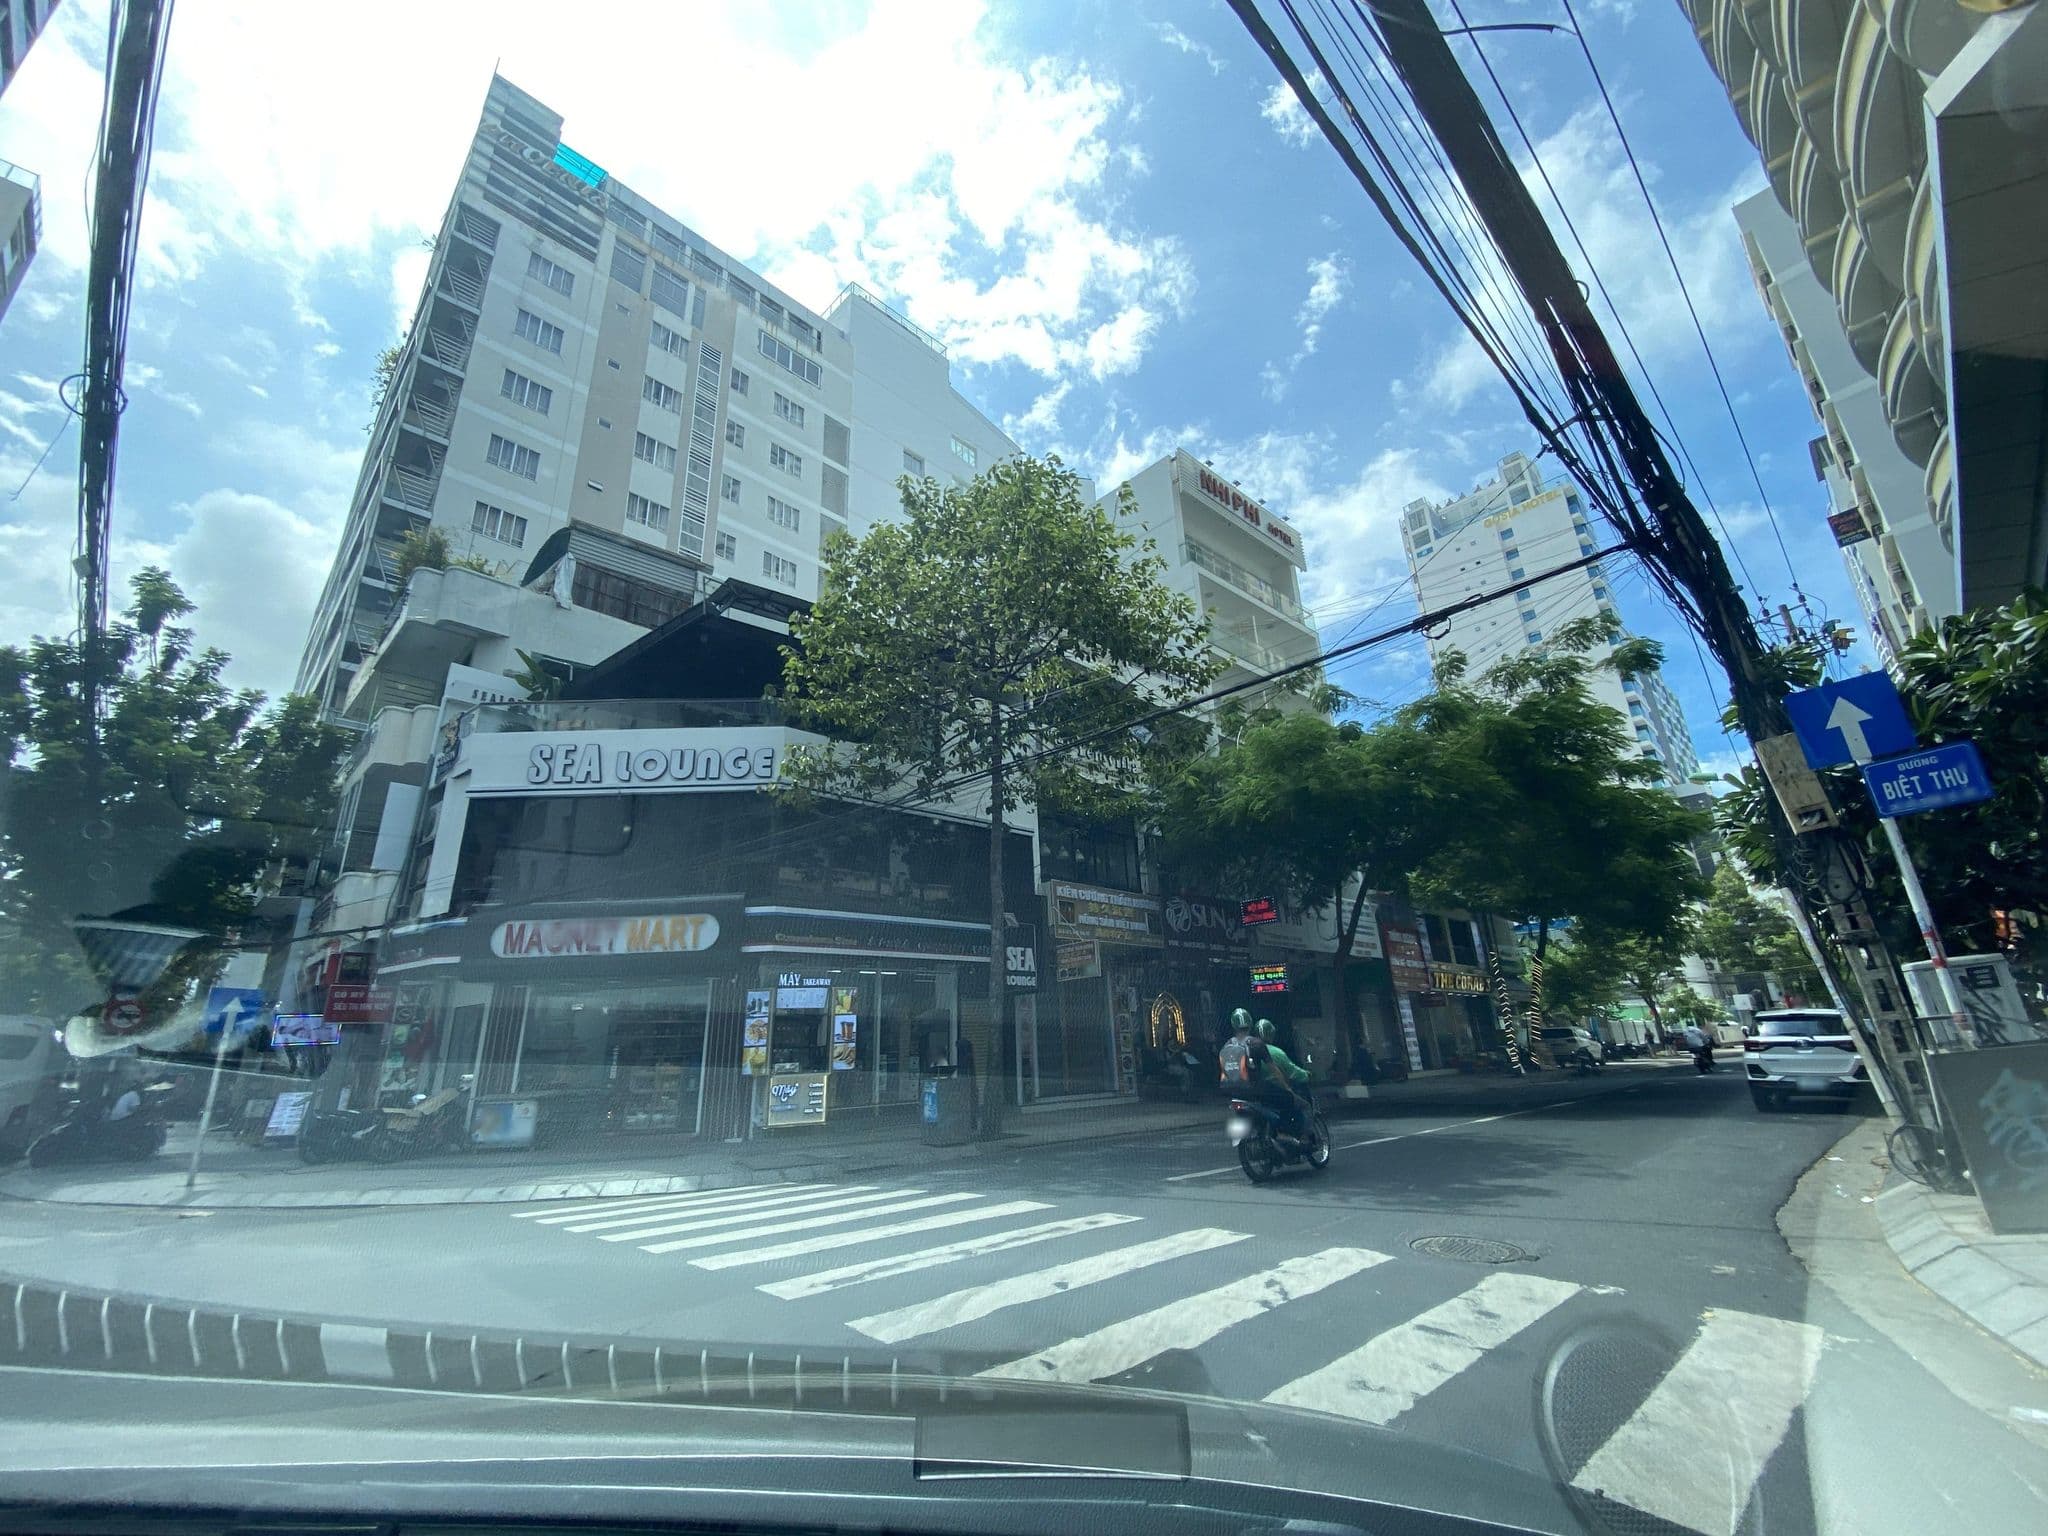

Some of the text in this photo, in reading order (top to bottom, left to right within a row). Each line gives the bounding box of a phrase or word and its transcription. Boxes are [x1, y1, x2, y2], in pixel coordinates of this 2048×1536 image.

[1231, 491, 1262, 526] PHI
[1521, 490, 1562, 511] HOTEL
[527, 743, 775, 784] SEA LOUNGE
[1881, 774, 1923, 800] BIỆT
[626, 916, 705, 952] MART
[1006, 946, 1036, 972] SEA
[778, 971, 832, 986] MÂY TAKEAWAY
[1006, 974, 1037, 987] LOUNGE
[1433, 972, 1454, 989] THE
